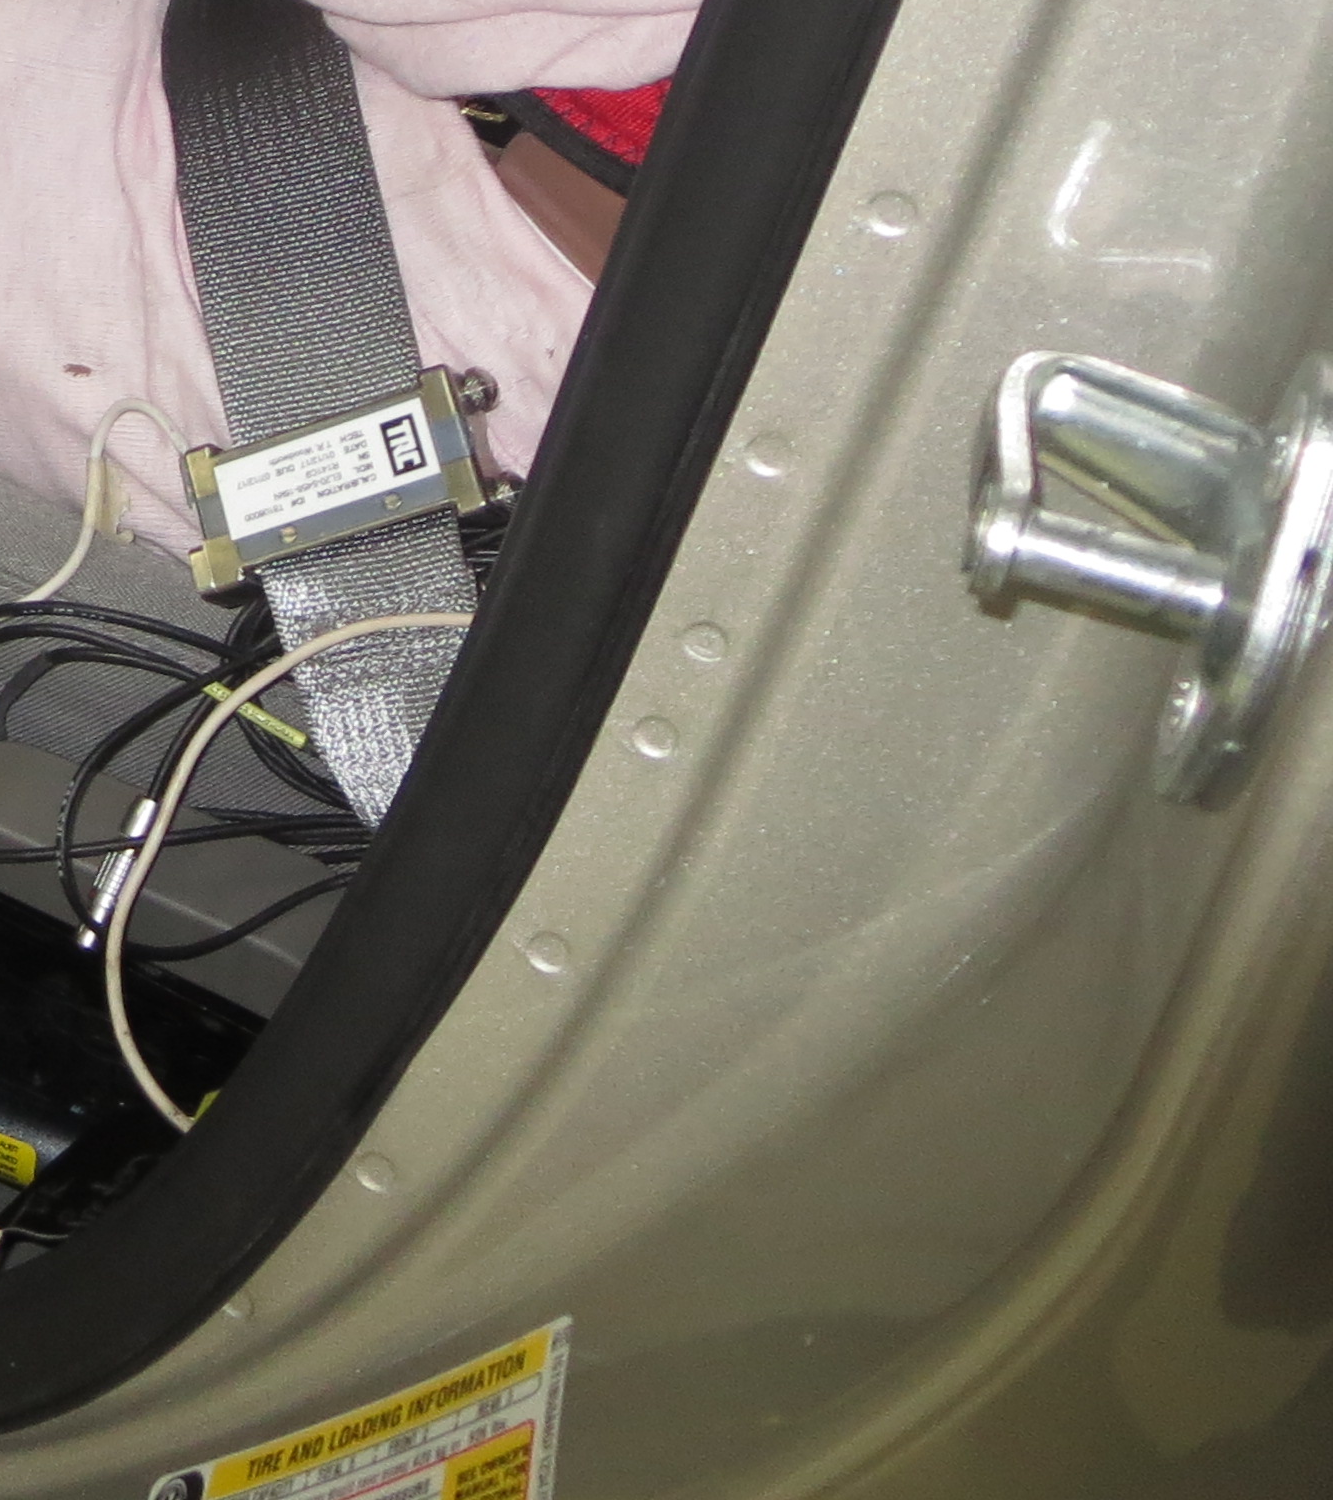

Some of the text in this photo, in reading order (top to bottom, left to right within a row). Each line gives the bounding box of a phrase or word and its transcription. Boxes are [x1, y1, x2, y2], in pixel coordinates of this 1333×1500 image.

[342, 439, 367, 454] DATE
[383, 417, 423, 471] TRC
[316, 472, 377, 498] CALIBRATION
[248, 1448, 283, 1481] TIRE
[287, 1434, 323, 1466] AND
[329, 1403, 401, 1450] LOADING
[409, 1349, 525, 1419] INFORMATION
